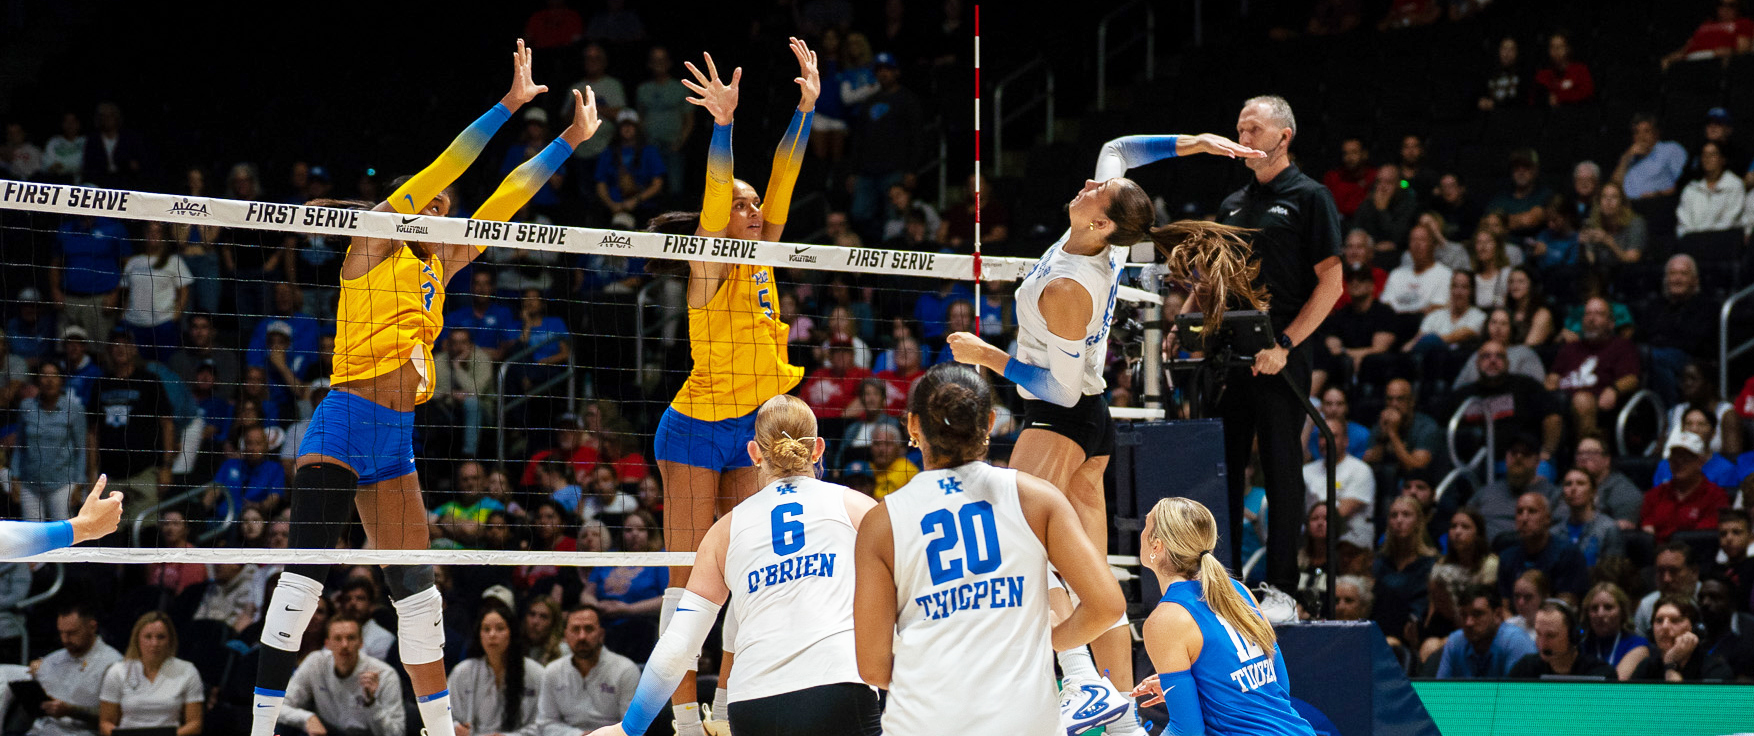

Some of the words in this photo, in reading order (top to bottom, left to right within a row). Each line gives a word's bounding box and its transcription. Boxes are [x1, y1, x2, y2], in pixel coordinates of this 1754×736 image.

[4, 182, 63, 205] FIRST
[68, 187, 130, 211] SERVE
[246, 203, 299, 224] FIRST
[303, 207, 359, 229] SERVE
[396, 224, 428, 234] VOLLEYBALL
[465, 220, 512, 240] FIRST
[516, 225, 567, 245] SERVE
[663, 236, 708, 255] FIRST
[711, 239, 758, 258] SERVE
[788, 254, 817, 263] VOLLEYBALL
[847, 249, 888, 268] FIRST
[892, 253, 935, 271] SERVE
[758, 288, 774, 319] 5
[771, 502, 805, 556] 6
[920, 500, 1002, 586] 20
[748, 553, 836, 593] O'BRIEN
[915, 576, 1024, 620] THIGPEN
